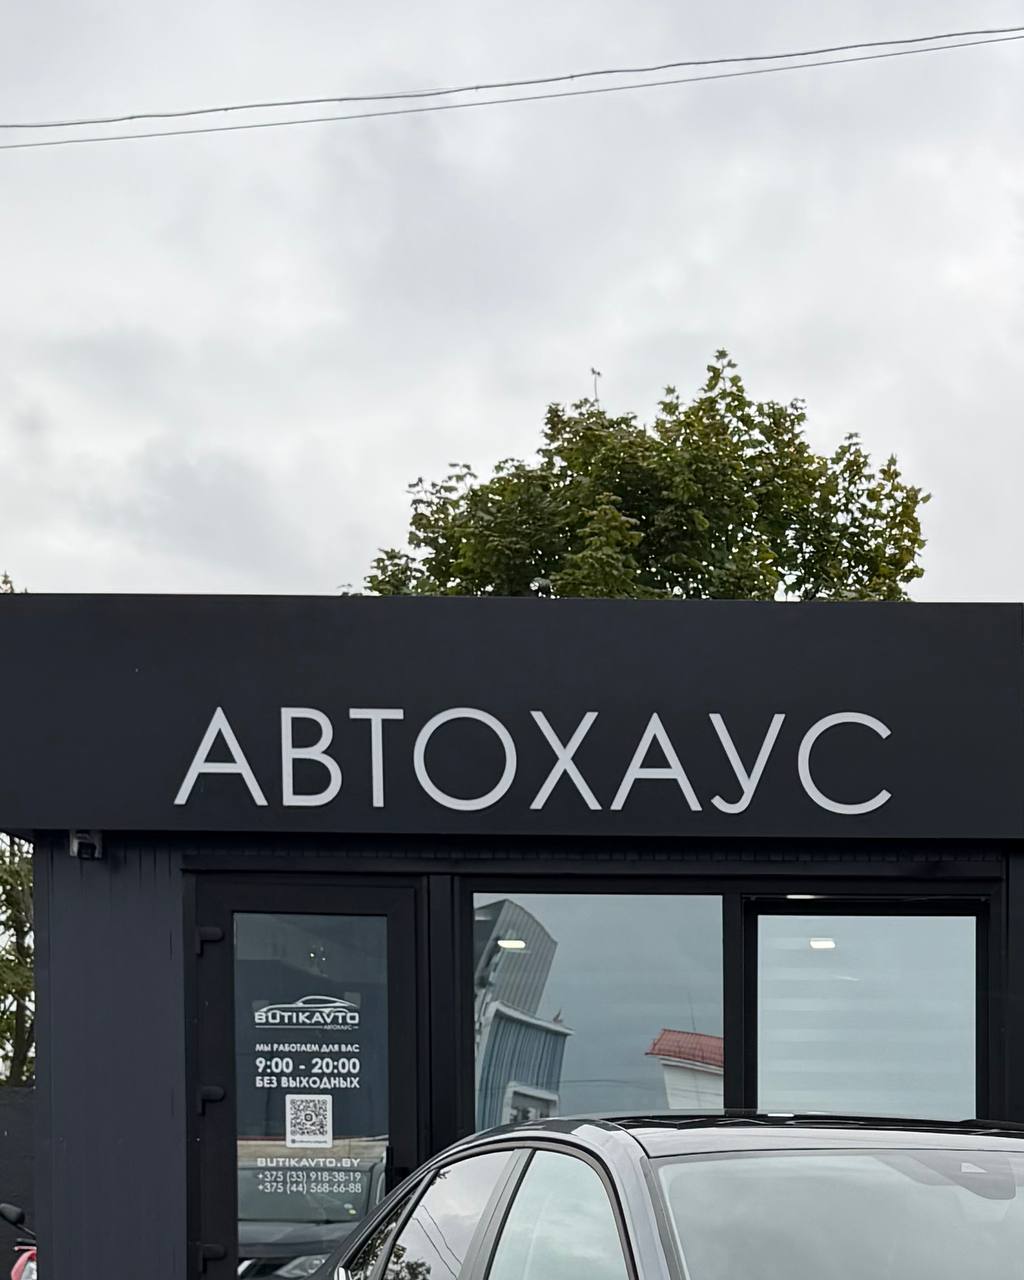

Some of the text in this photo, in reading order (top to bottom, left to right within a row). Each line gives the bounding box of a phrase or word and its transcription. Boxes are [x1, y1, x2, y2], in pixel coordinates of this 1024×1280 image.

[174, 706, 892, 815] АВТОХАУС
[254, 1011, 359, 1024] BUTIKAVTO
[255, 1043, 360, 1053] МЫ РАБОТАЕМ ДЛЯ ВАС
[255, 1057, 294, 1074] 9:00
[311, 1057, 360, 1074] 20:00
[255, 1076, 360, 1089] БЕЗ ВЫХОДНЫХ
[256, 1157, 361, 1167] BUTIKAVTO.BY
[257, 1171, 362, 1183] +375 (33) 918-38-19
[257, 1182, 362, 1194] +375 (44) 568-66-88
